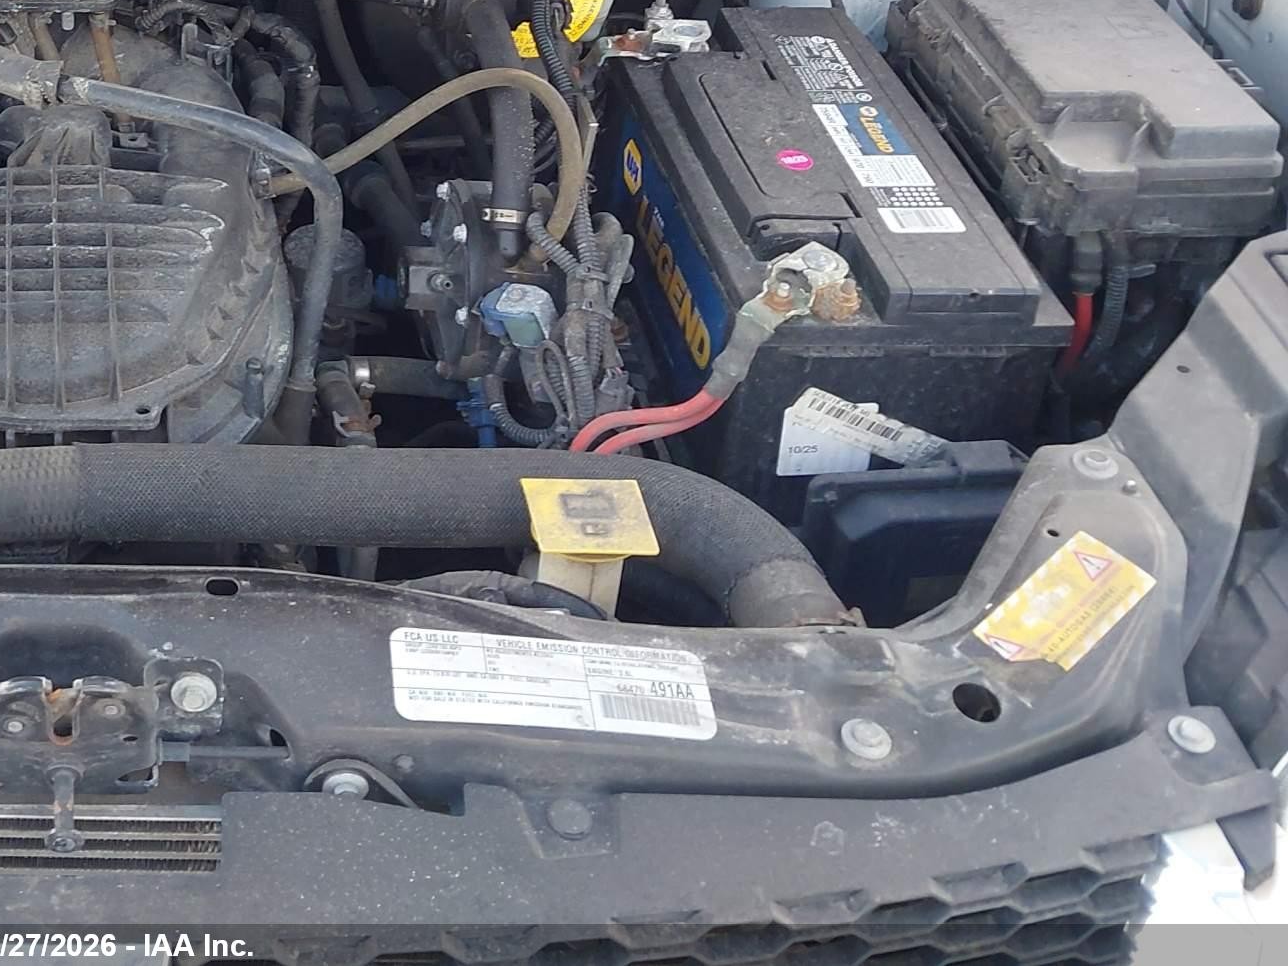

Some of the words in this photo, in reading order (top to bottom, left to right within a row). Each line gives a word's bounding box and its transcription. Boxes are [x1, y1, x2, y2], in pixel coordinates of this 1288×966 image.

[635, 194, 711, 371] LEGEND
[787, 444, 819, 454] 10/25
[404, 632, 422, 641] FCA
[425, 634, 438, 642] US
[441, 635, 459, 644] LLC
[496, 639, 532, 650] VEHICLE
[536, 642, 579, 653] EMISSION
[581, 646, 620, 657] CONTROL
[624, 650, 689, 663] INFORMATION
[650, 681, 696, 699] 491AA
